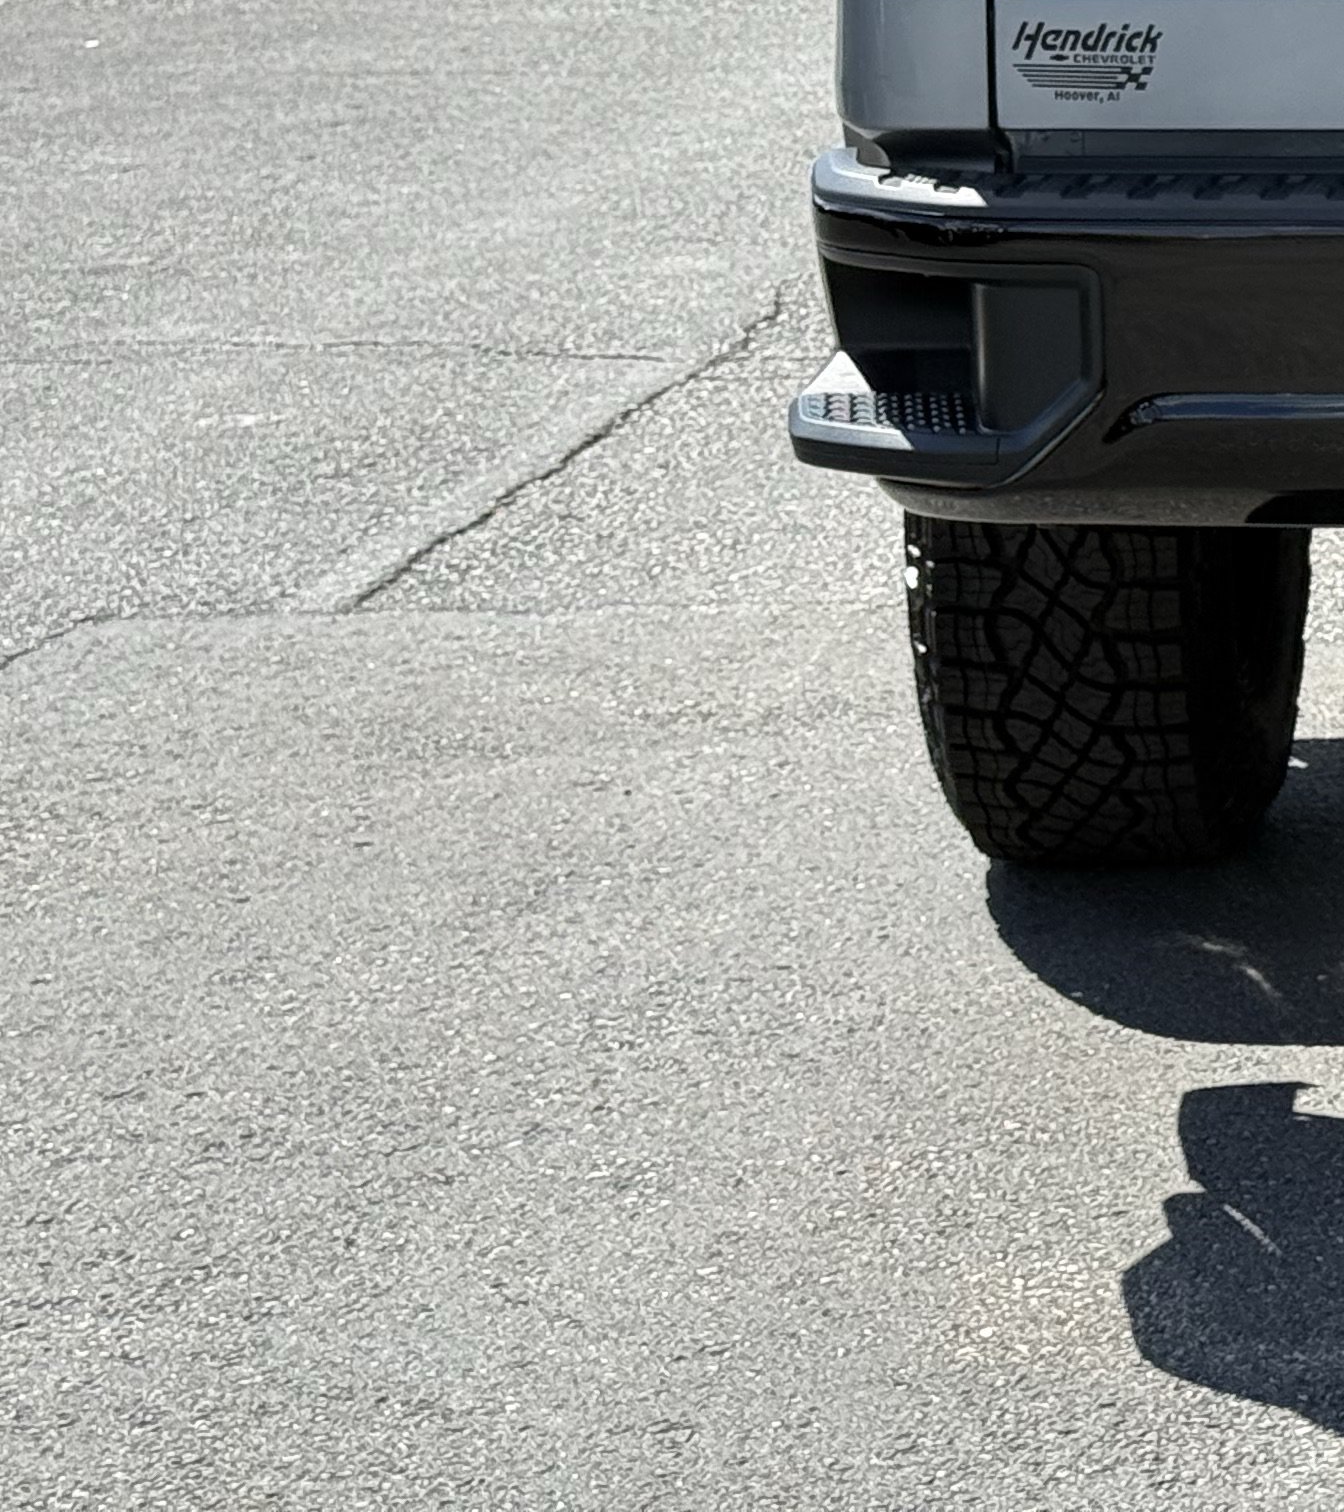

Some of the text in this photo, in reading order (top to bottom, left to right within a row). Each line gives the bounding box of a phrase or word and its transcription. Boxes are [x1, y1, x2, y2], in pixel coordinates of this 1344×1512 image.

[1012, 21, 1163, 60] Hendrick
[1073, 53, 1156, 65] CHEVROLET
[1054, 90, 1104, 104] Hoover,
